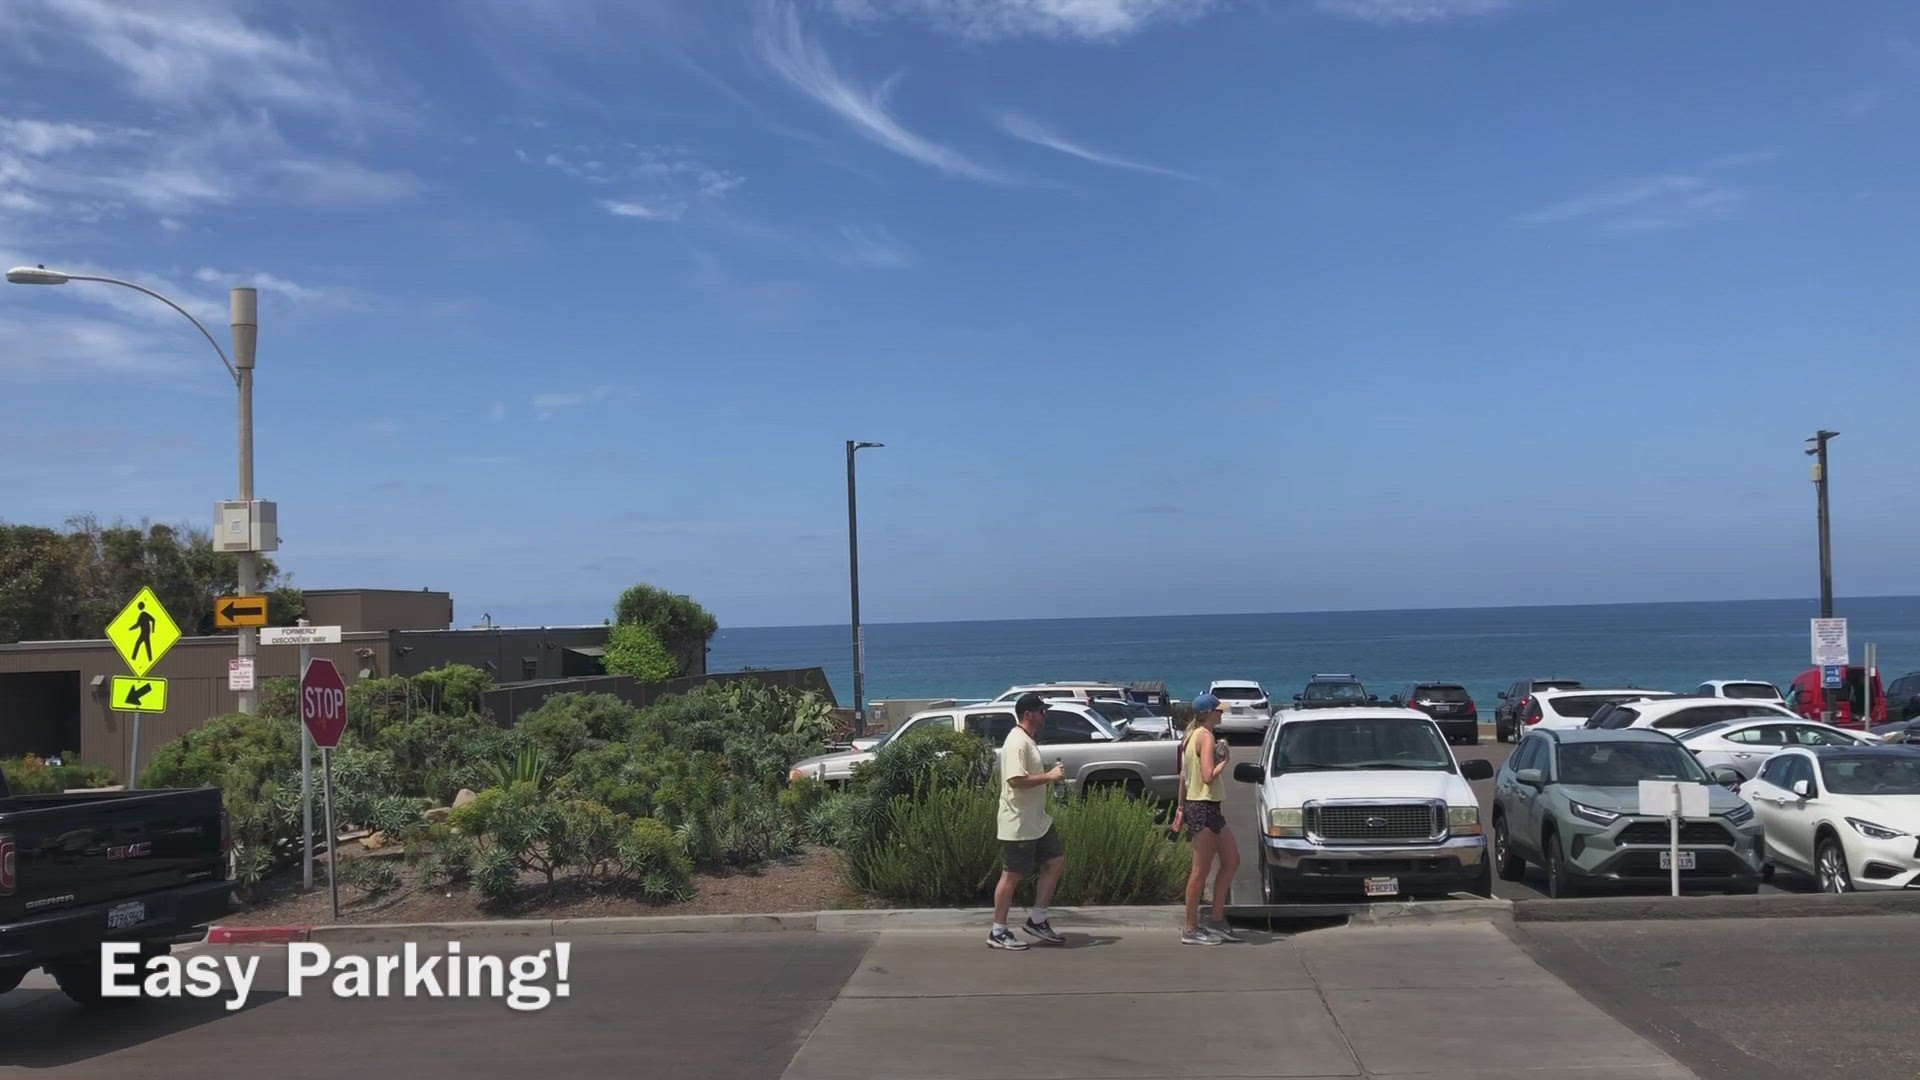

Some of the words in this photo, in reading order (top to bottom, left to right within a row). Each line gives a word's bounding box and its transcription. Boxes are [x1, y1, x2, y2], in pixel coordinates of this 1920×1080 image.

[282, 627, 317, 635] FORMERLY
[272, 636, 311, 644] DISCOVERY
[313, 635, 327, 643] WAY
[305, 686, 343, 719] STOP
[107, 841, 152, 860] GMC
[25, 894, 75, 909] SIERRA
